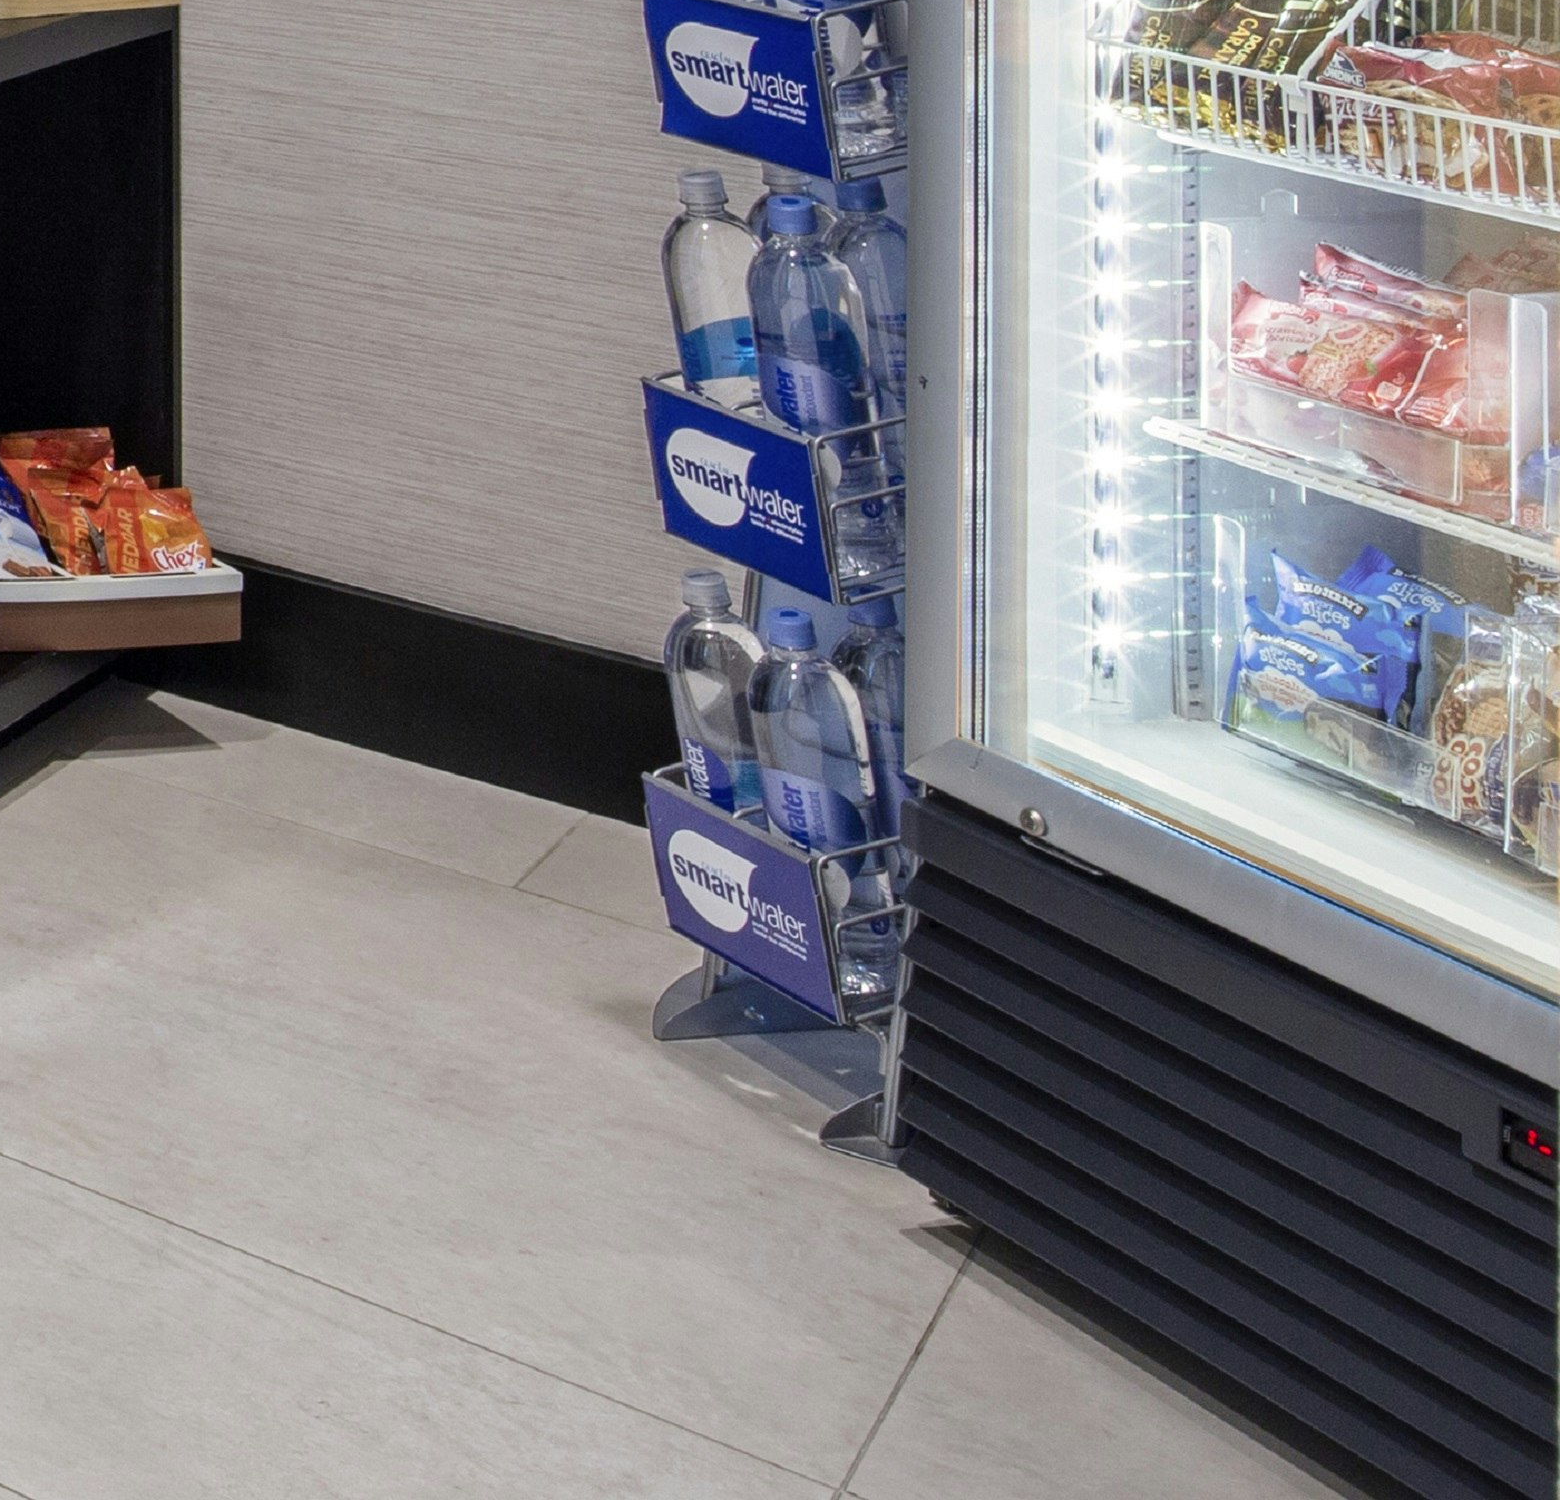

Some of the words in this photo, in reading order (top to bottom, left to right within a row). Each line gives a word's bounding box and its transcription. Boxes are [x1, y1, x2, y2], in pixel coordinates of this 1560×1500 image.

[671, 49, 809, 107] smartwater
[671, 452, 805, 526] smartwater
[152, 540, 204, 572] Chex
[673, 852, 807, 944] smartwater
